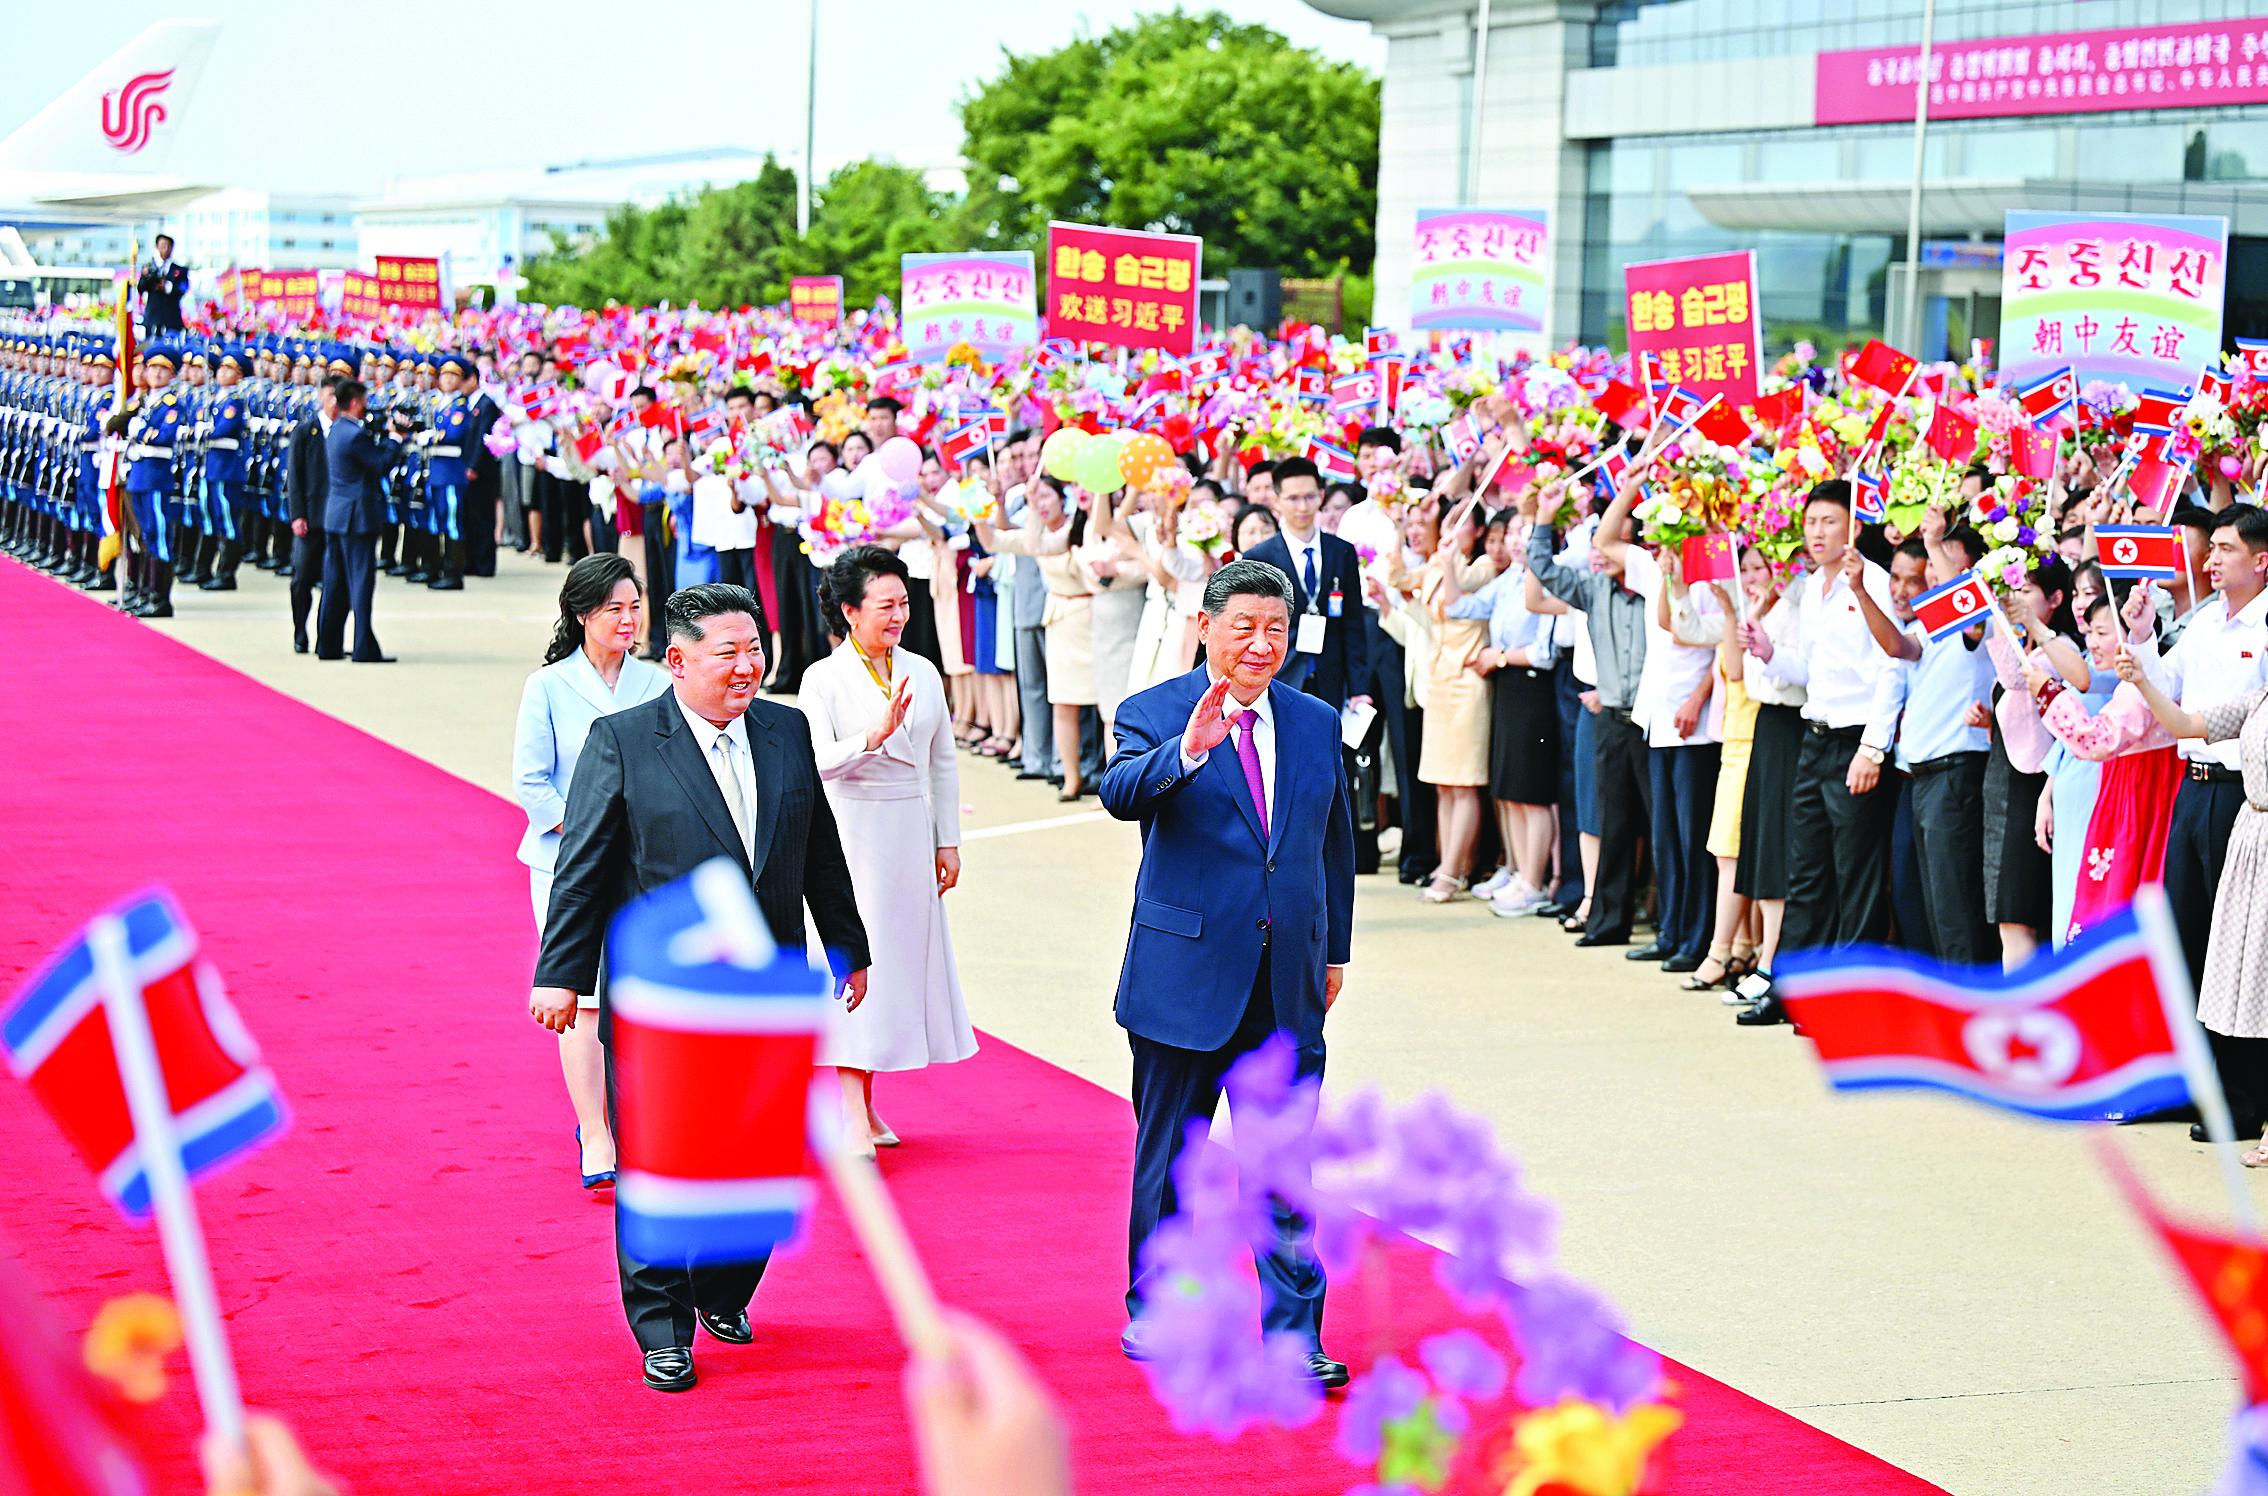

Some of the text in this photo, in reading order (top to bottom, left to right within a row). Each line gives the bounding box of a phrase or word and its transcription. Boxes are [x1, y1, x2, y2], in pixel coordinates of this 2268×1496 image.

[1056, 245, 1191, 292] 환송 습근평
[2017, 241, 2207, 298] 조중친선
[1058, 292, 1185, 334] 欢送习近平
[1630, 280, 1749, 332] 환송 습근평
[2032, 315, 2185, 361] 朝中友谊
[1639, 343, 1748, 384] 送习近平
